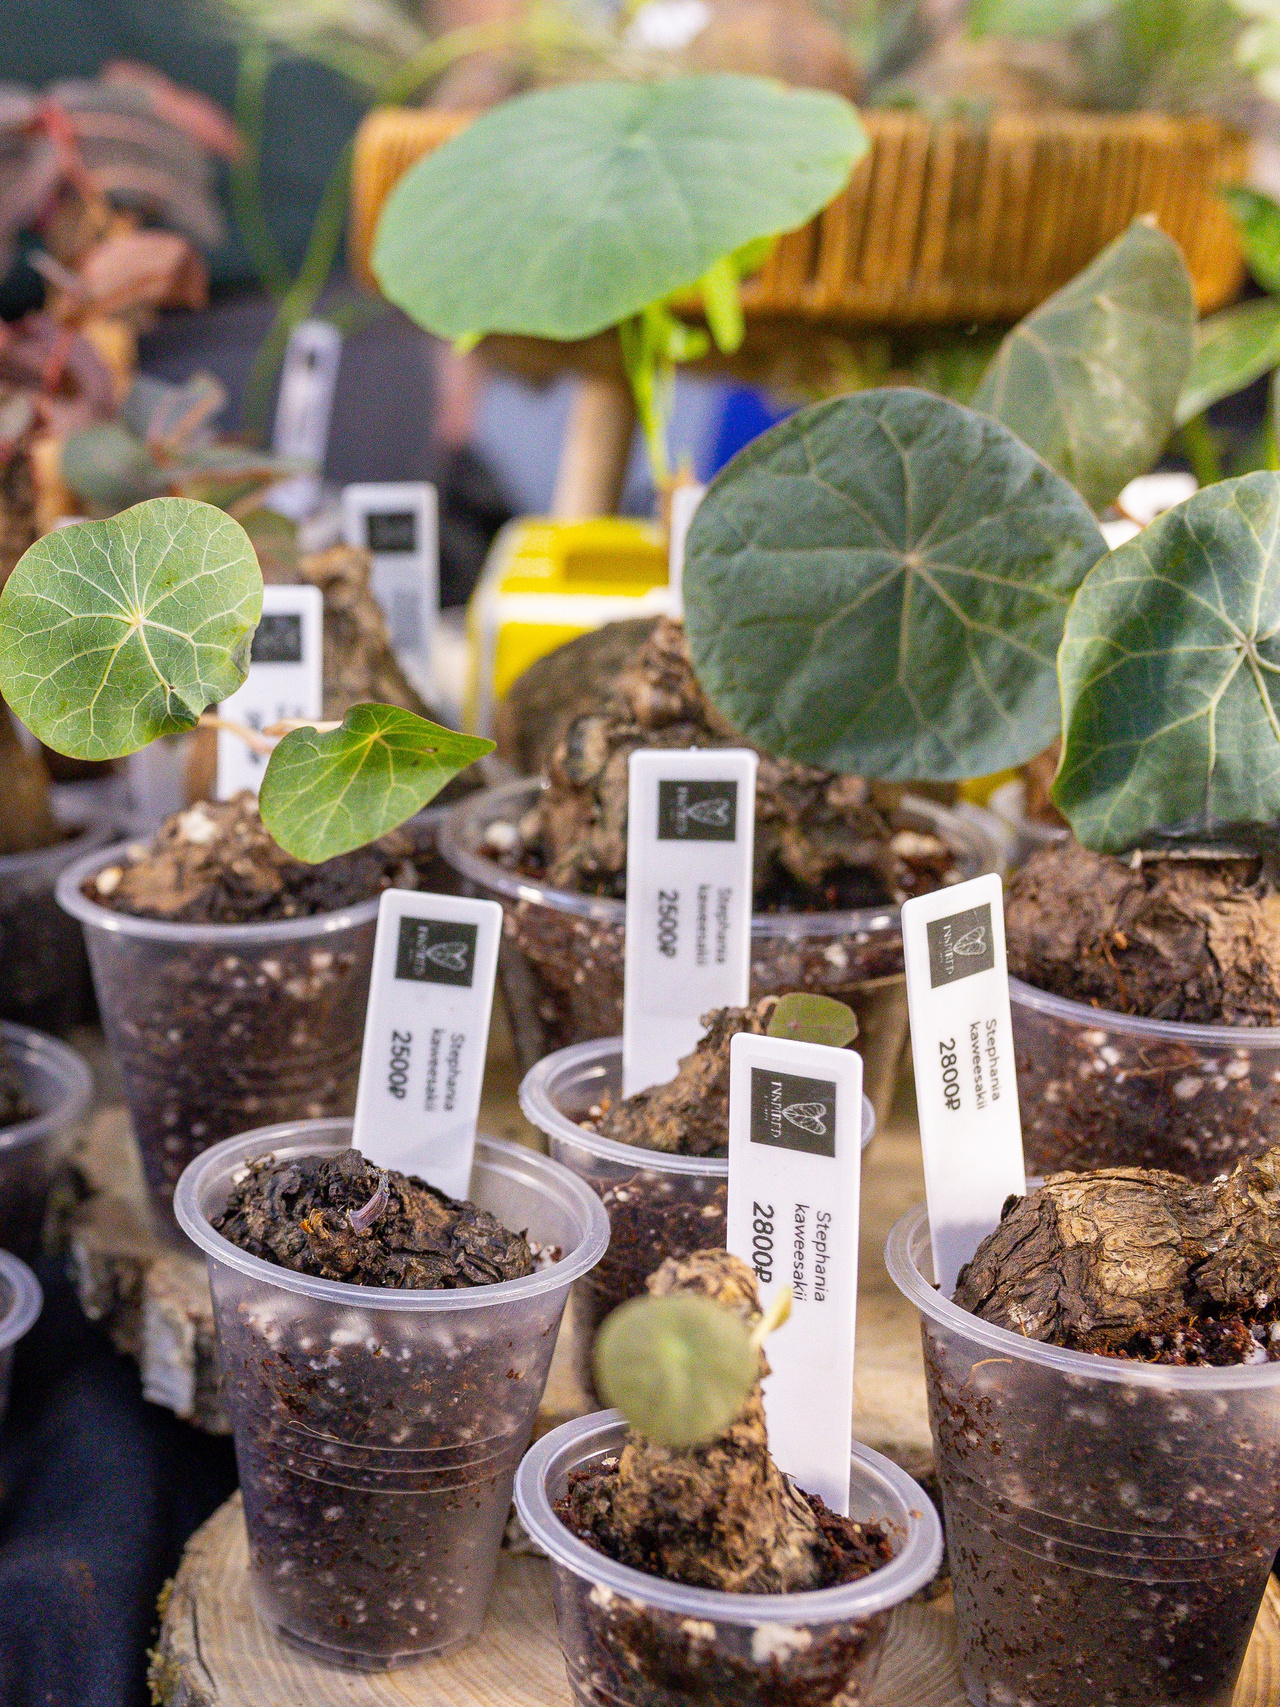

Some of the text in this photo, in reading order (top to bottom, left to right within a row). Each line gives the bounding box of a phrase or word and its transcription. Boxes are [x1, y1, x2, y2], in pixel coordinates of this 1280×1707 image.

[388, 1030, 413, 1101] 2500₽
[424, 1028, 446, 1112] kaweesakii
[444, 1032, 465, 1112] Stephania
[939, 1038, 962, 1111] 2800₽
[969, 1022, 987, 1110] kaweesakii
[984, 1019, 1002, 1101] Stephania
[753, 1201, 774, 1283] 2800₽
[793, 1203, 809, 1301] kaweesakii
[812, 1211, 831, 1302] Stephania
